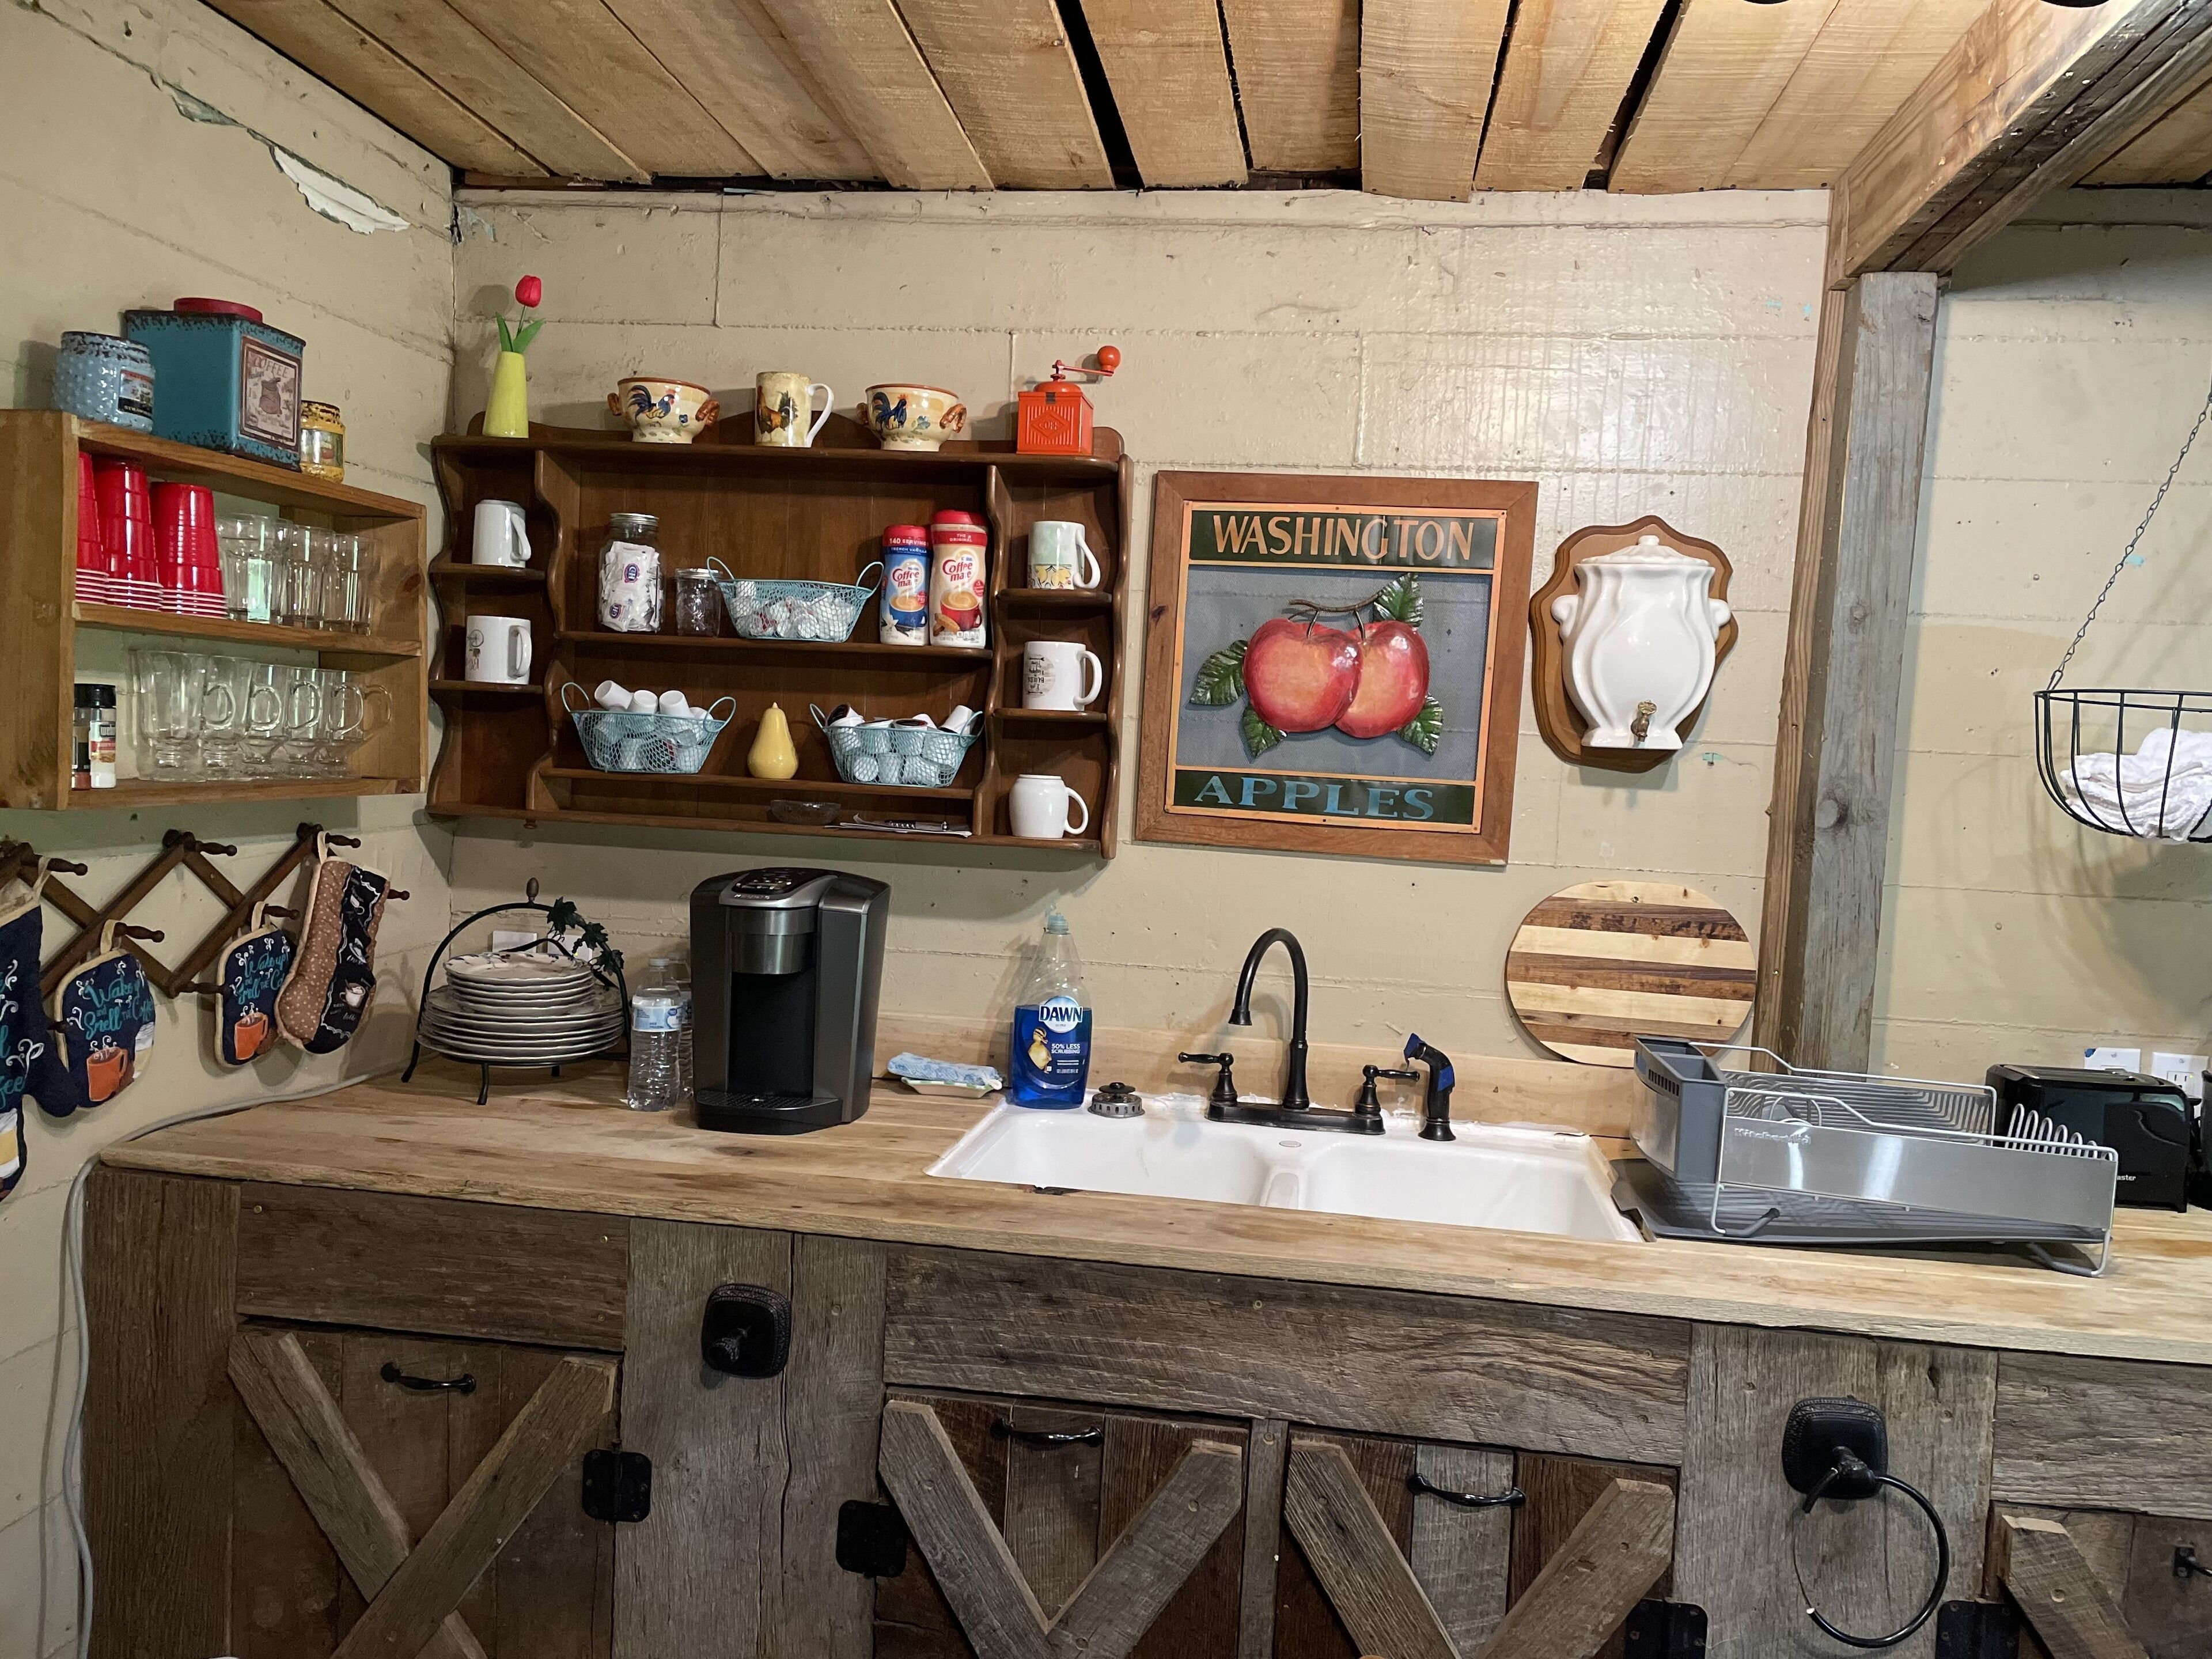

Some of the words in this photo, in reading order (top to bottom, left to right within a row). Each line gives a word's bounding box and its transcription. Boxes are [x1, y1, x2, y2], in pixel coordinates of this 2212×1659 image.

[254, 357, 289, 378] COFFEE
[1213, 514, 1474, 560] WASHINGTON
[942, 559, 973, 574] Coffee
[892, 569, 920, 582] Coffee
[950, 571, 972, 582] mae
[1194, 775, 1434, 820] APPLES
[1040, 1006, 1082, 1022] DAWN
[1734, 1127, 1812, 1145] KitchenAid
